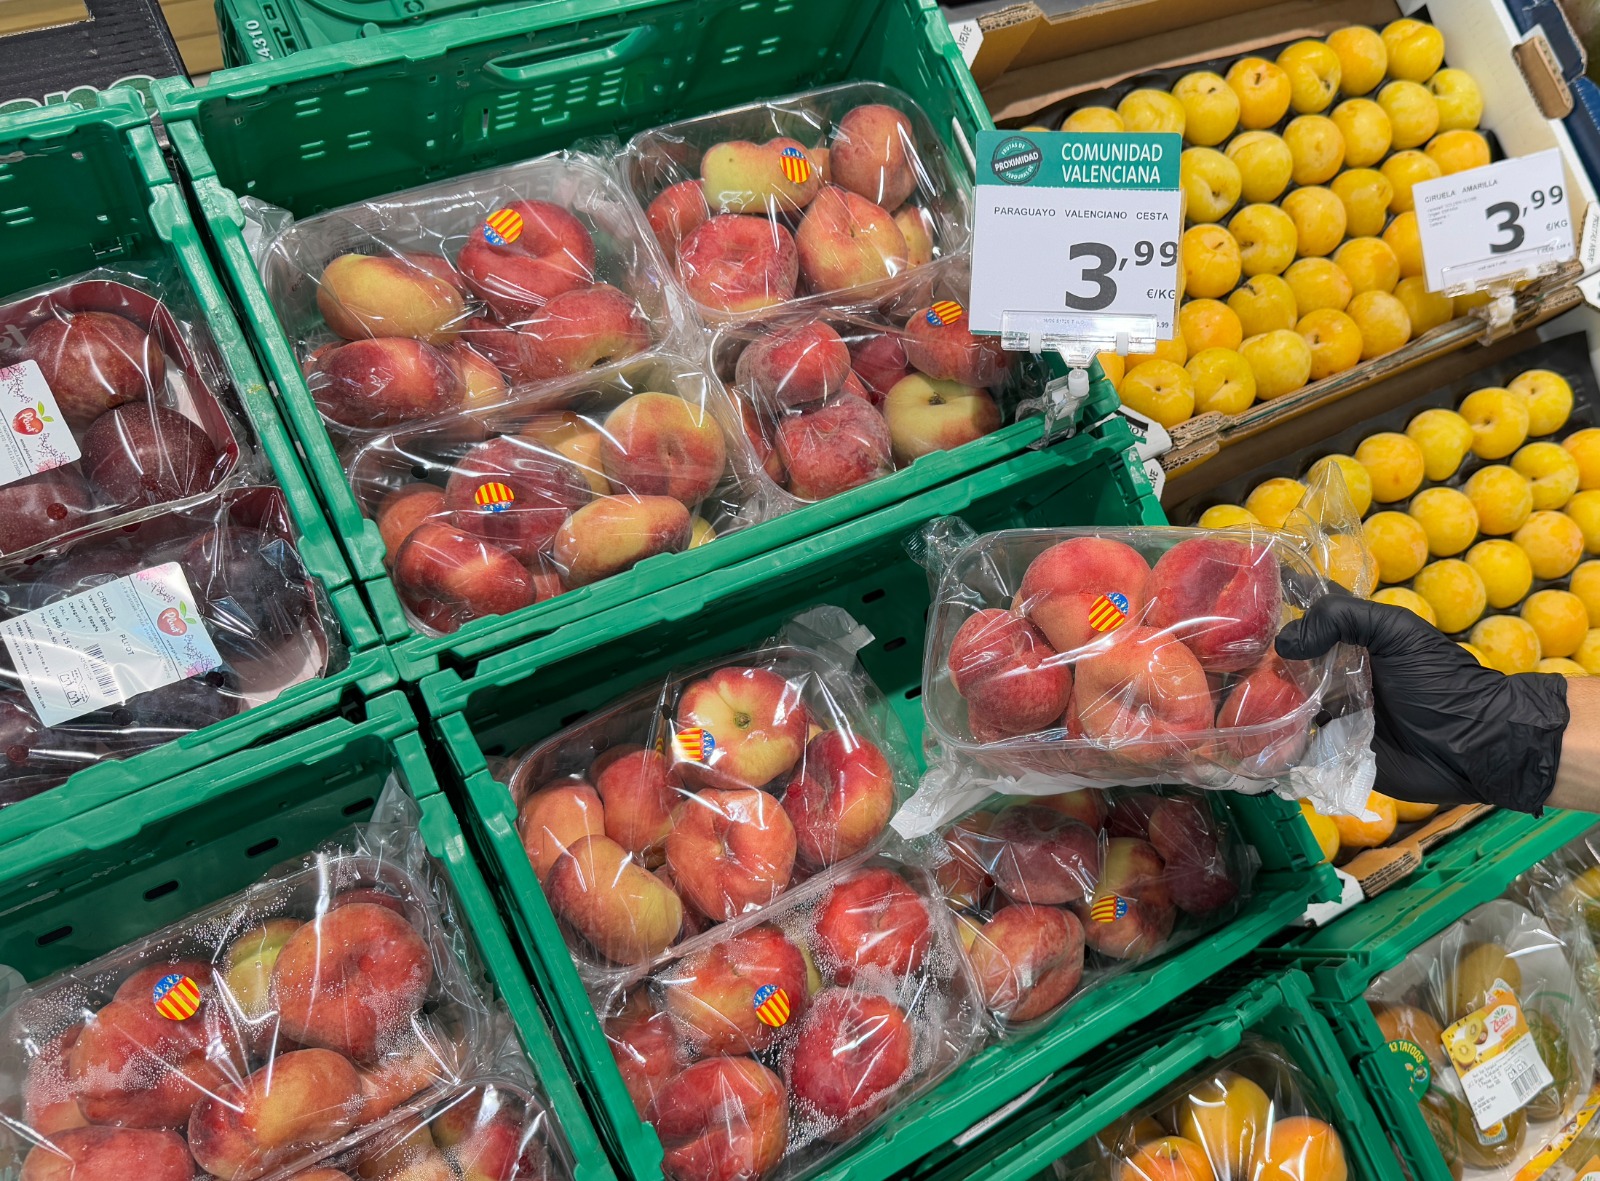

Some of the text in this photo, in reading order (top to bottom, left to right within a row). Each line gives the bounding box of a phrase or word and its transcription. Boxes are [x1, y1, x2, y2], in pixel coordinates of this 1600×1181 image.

[994, 151, 1039, 172] PROXIMIDAD
[1061, 143, 1163, 162] COMUNIDAD
[1062, 166, 1161, 184] VALENCIANA
[1424, 179, 1498, 204] CIRUELA AMARILLA
[994, 206, 1169, 221] PARAGUAYO VALENCIANO CESTA
[1485, 185, 1564, 254] 3,99
[1065, 241, 1178, 311] 3,99
[96, 590, 135, 657] CIRUELA PLUOT
[161, 609, 184, 636] Pluot
[1399, 1041, 1425, 1064] TATOOS
